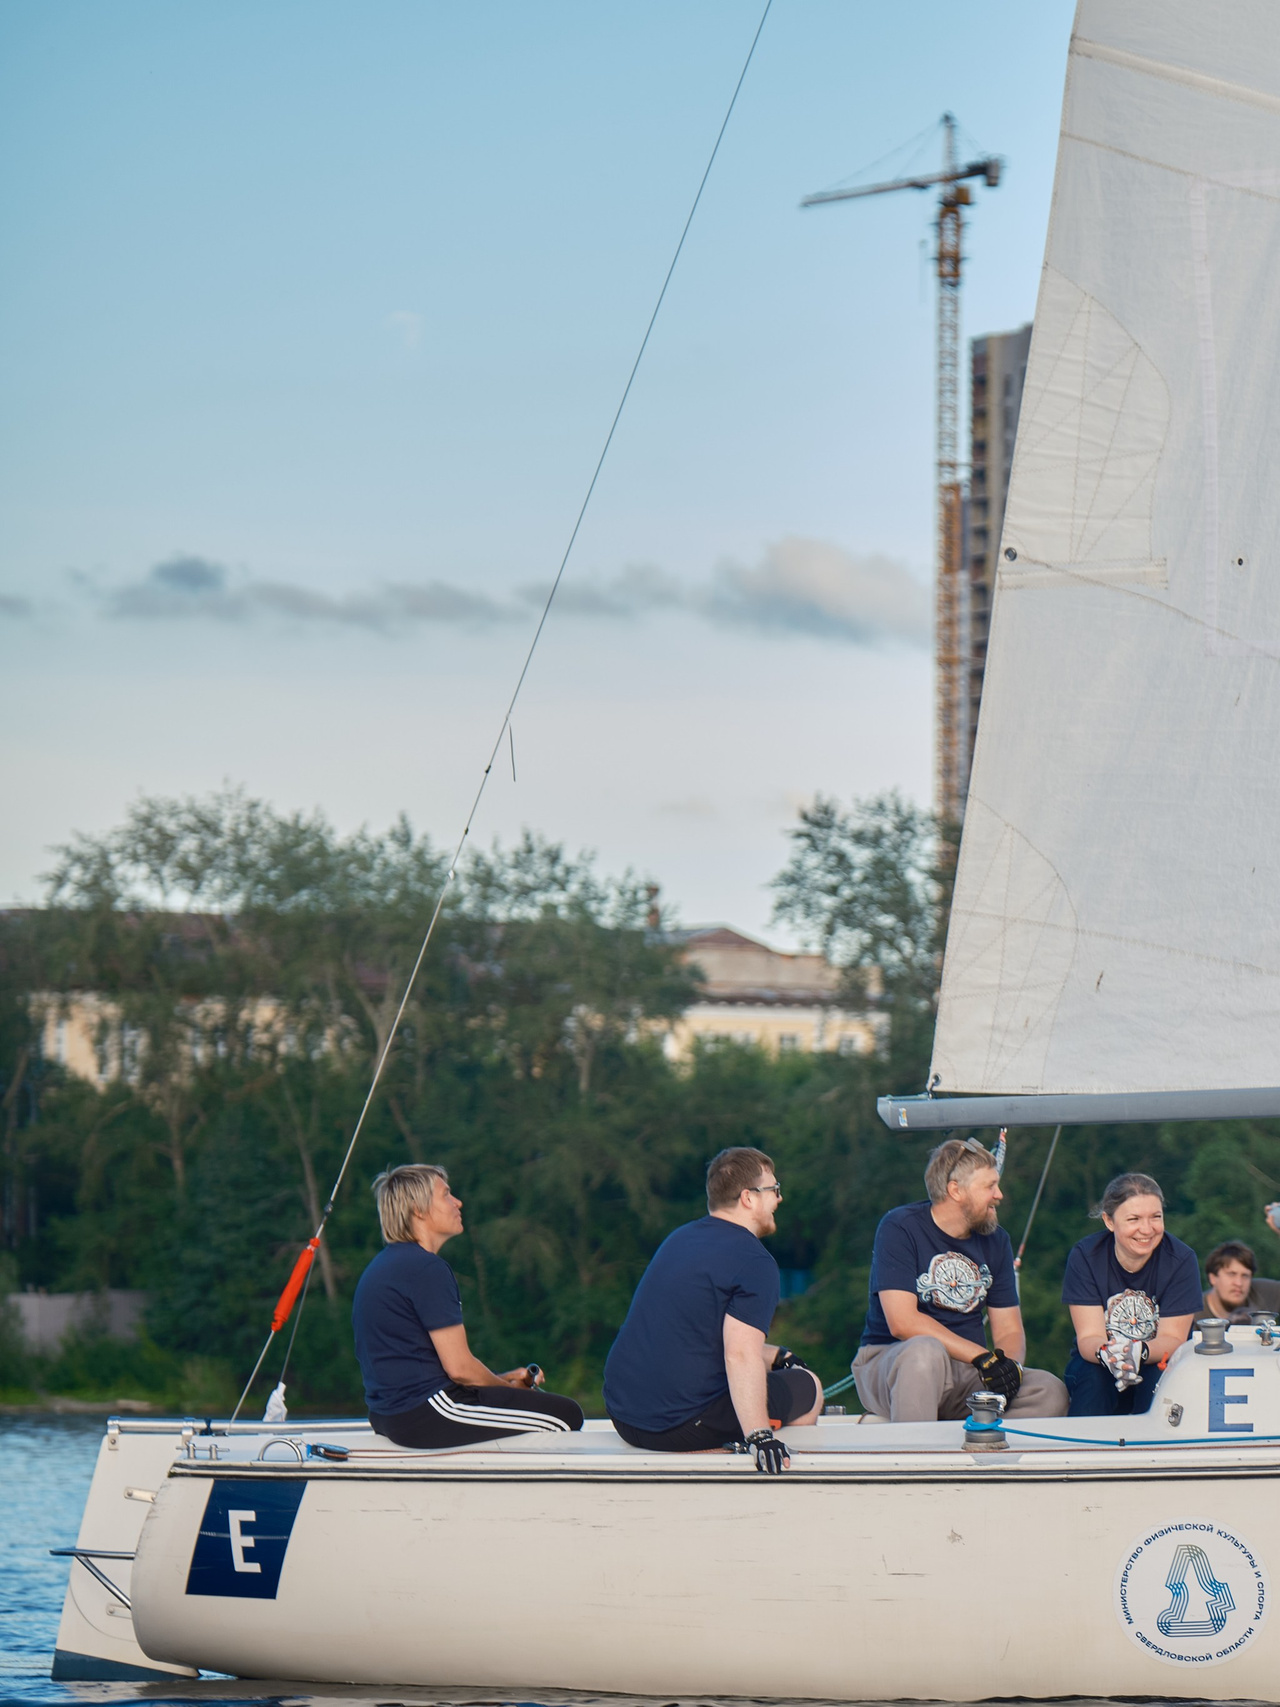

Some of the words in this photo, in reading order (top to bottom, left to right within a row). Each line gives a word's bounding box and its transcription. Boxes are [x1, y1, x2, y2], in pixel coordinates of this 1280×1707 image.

[1207, 1368, 1255, 1432] E
[228, 1510, 262, 1573] E
[1143, 1523, 1214, 1546] ФИЗИЧЕСКОЙ
[1216, 1529, 1258, 1569] КУЛЬТУРЫ
[1119, 1546, 1144, 1625] МИНИСТЕРСТВО
[1254, 1570, 1262, 1578] И
[1253, 1581, 1265, 1621] СПОРТА
[1135, 1631, 1213, 1662] СВЕРДЛОВСКОЙ
[1215, 1627, 1255, 1658] ОБЛАСТИ
